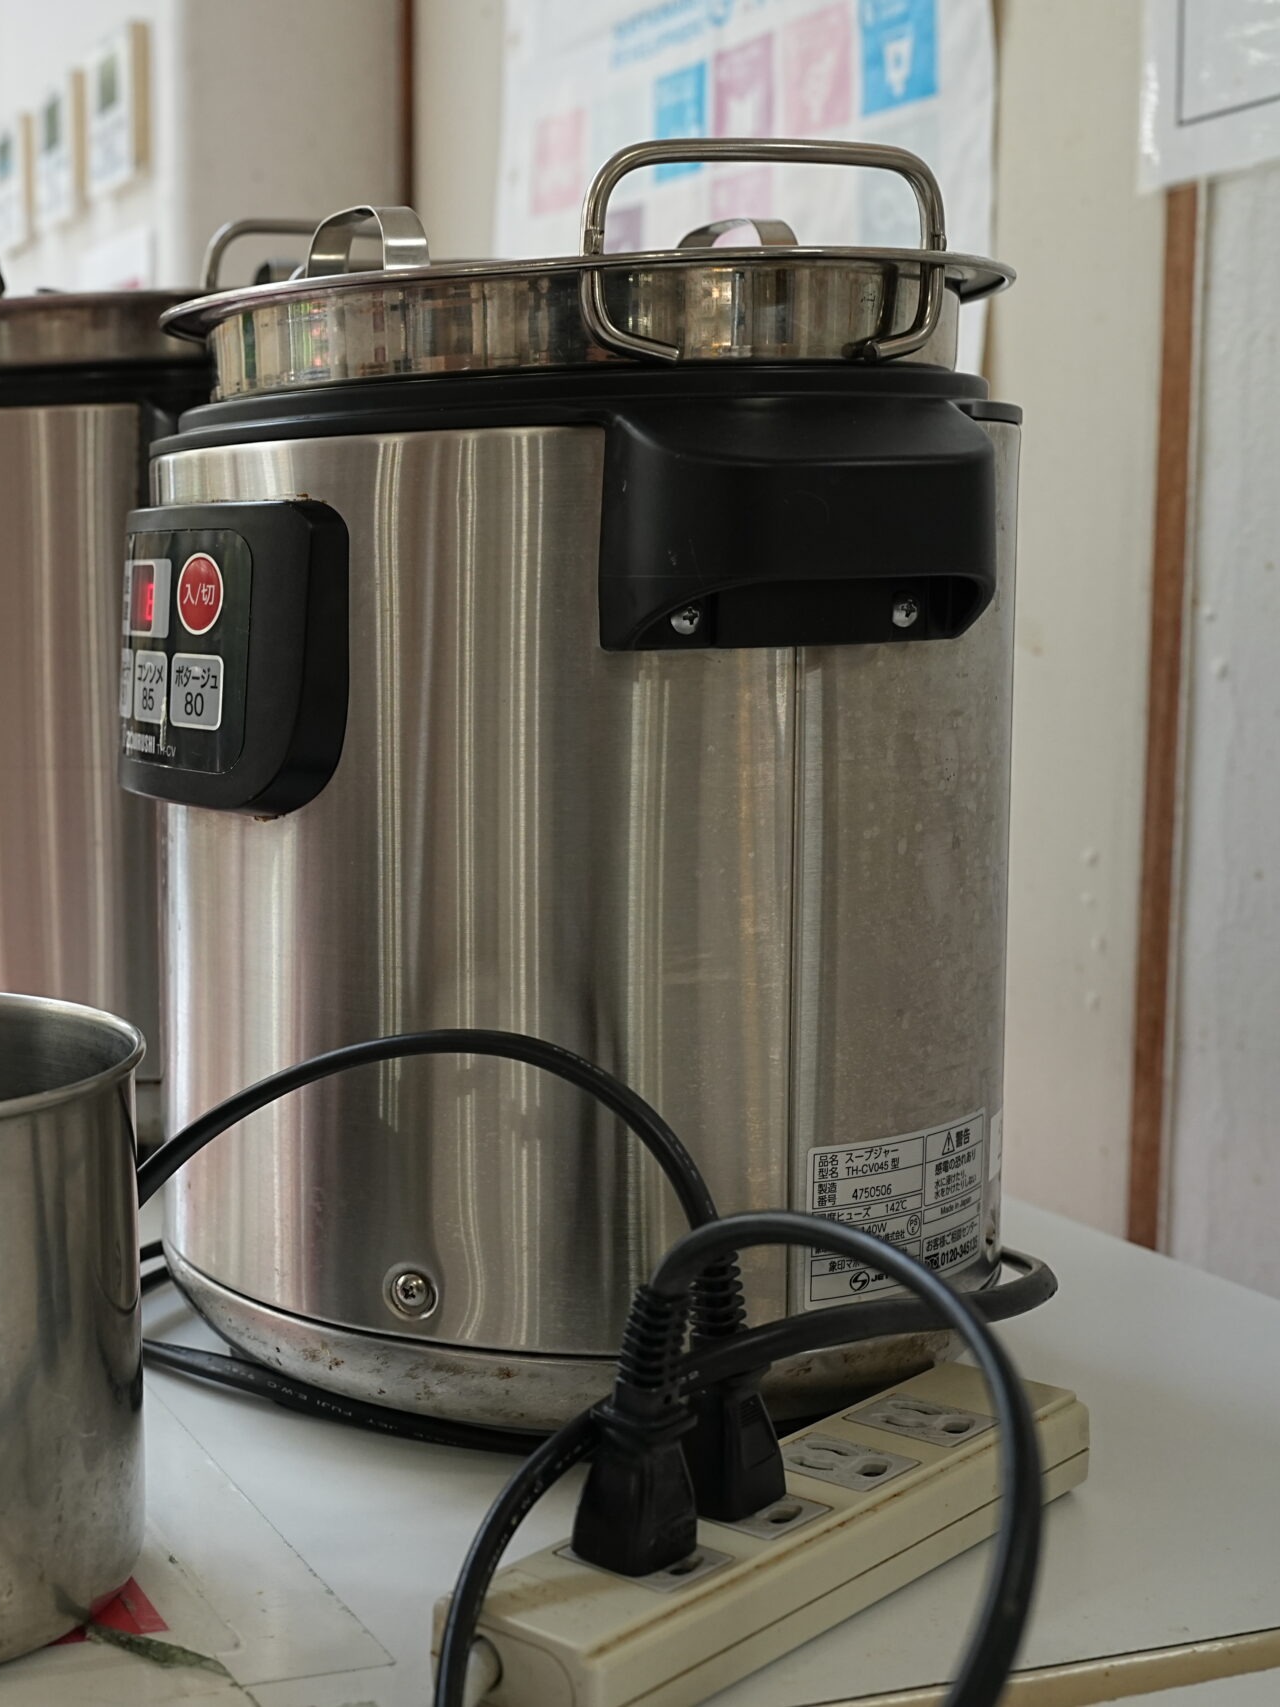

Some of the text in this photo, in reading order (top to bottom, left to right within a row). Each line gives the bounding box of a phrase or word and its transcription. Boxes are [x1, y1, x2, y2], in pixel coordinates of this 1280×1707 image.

[183, 583, 215, 606] 入/切
[137, 664, 163, 684] コンソメ
[175, 665, 218, 689] ポタージュ
[142, 687, 154, 711] 85
[184, 691, 204, 717] 80
[818, 1146, 899, 1168] 品名 スープジャー
[818, 1167, 839, 1180] 型名
[846, 1161, 889, 1176] TH-CV045
[818, 1182, 837, 1195] 製造
[852, 1184, 892, 1200] 4750506
[818, 1194, 837, 1207] 番号
